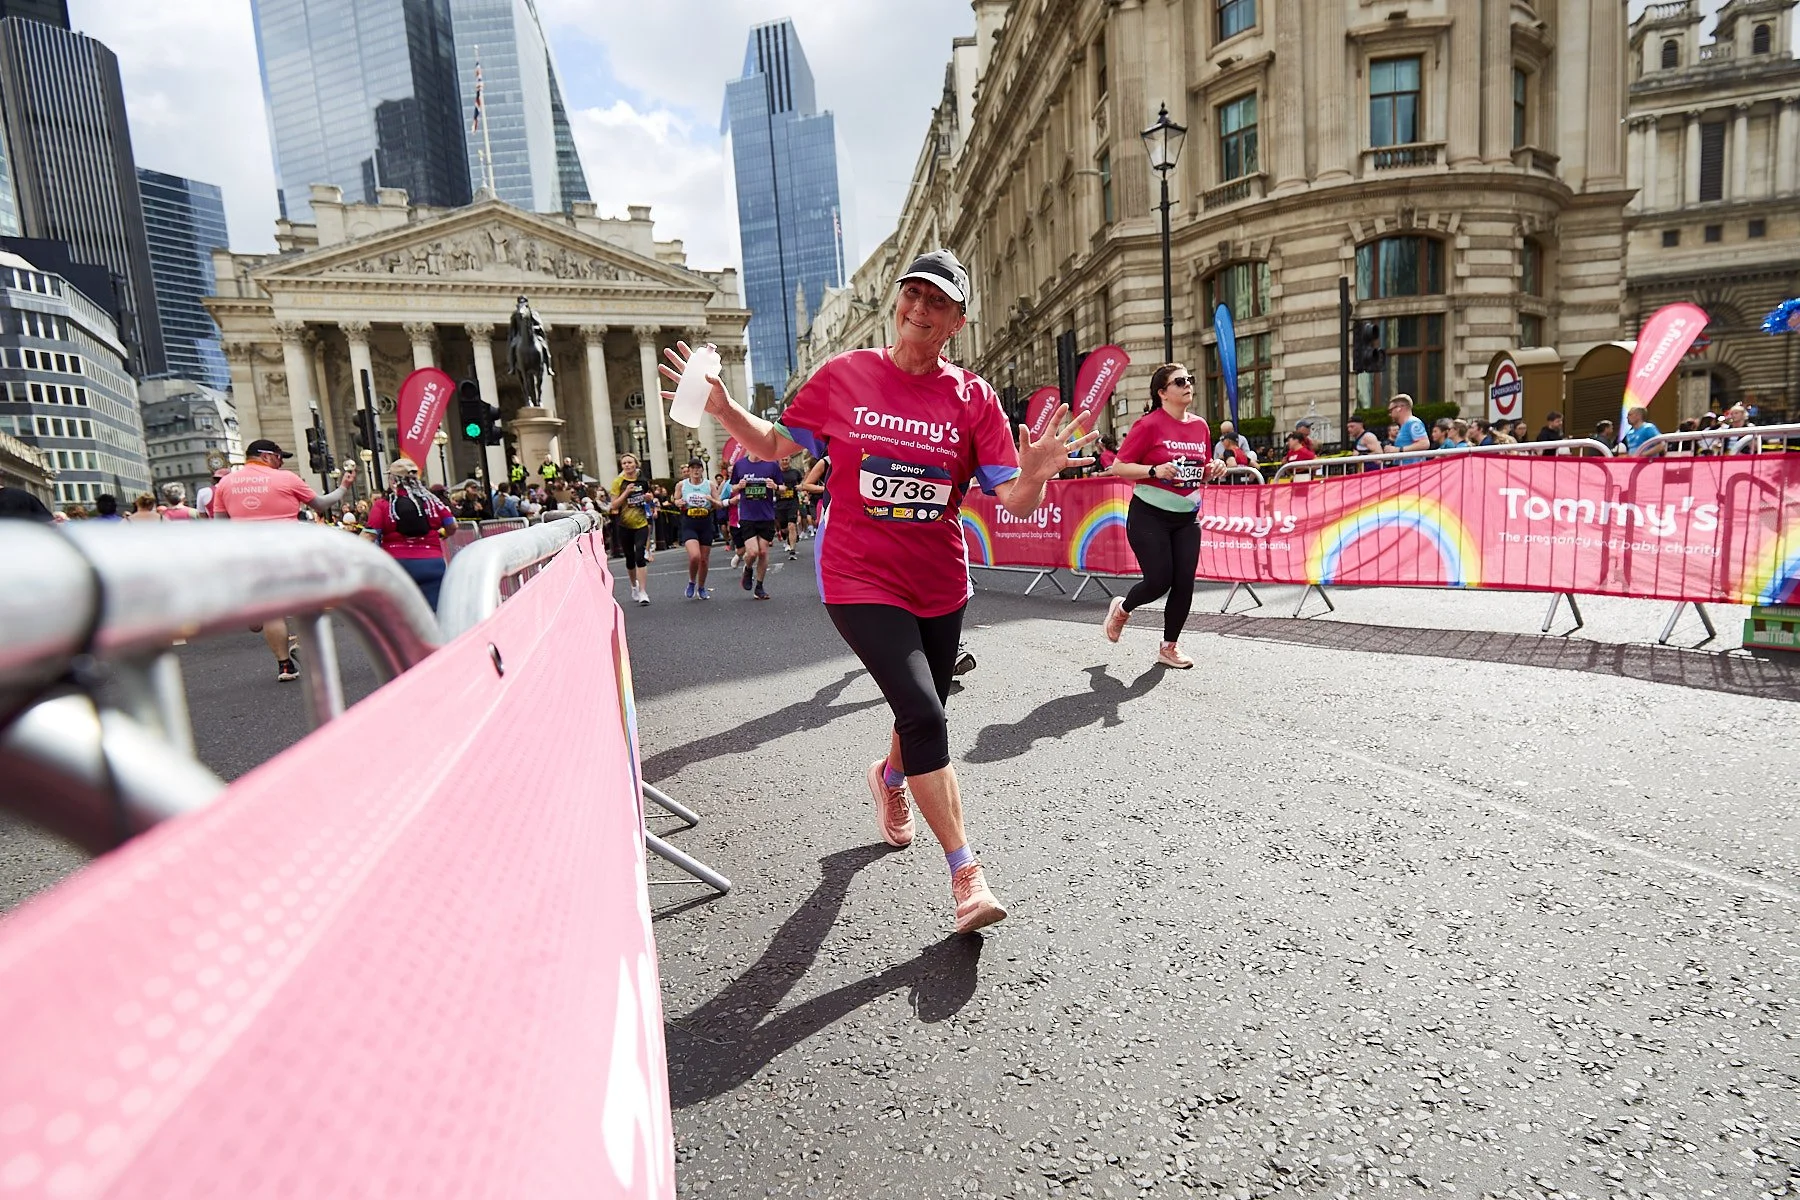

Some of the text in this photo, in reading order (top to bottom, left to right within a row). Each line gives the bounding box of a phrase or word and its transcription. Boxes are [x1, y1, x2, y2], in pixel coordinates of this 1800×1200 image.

[1636, 318, 1686, 378] Tommy's
[1080, 358, 1115, 408] Tommy's
[406, 382, 437, 440] Tommy's
[853, 406, 960, 444] Tommy's
[1030, 395, 1056, 435] Tommy's
[849, 431, 958, 459] The pregnancy and baby charity
[231, 475, 270, 484] SUPPORT
[890, 463, 926, 475] SPONGY
[231, 486, 269, 495] RUNNER
[871, 477, 937, 501] 9736
[1498, 487, 1720, 537] Tommy's
[1259, 540, 1291, 551] charity
[1498, 531, 1721, 558] The pregnancy and baby charity
